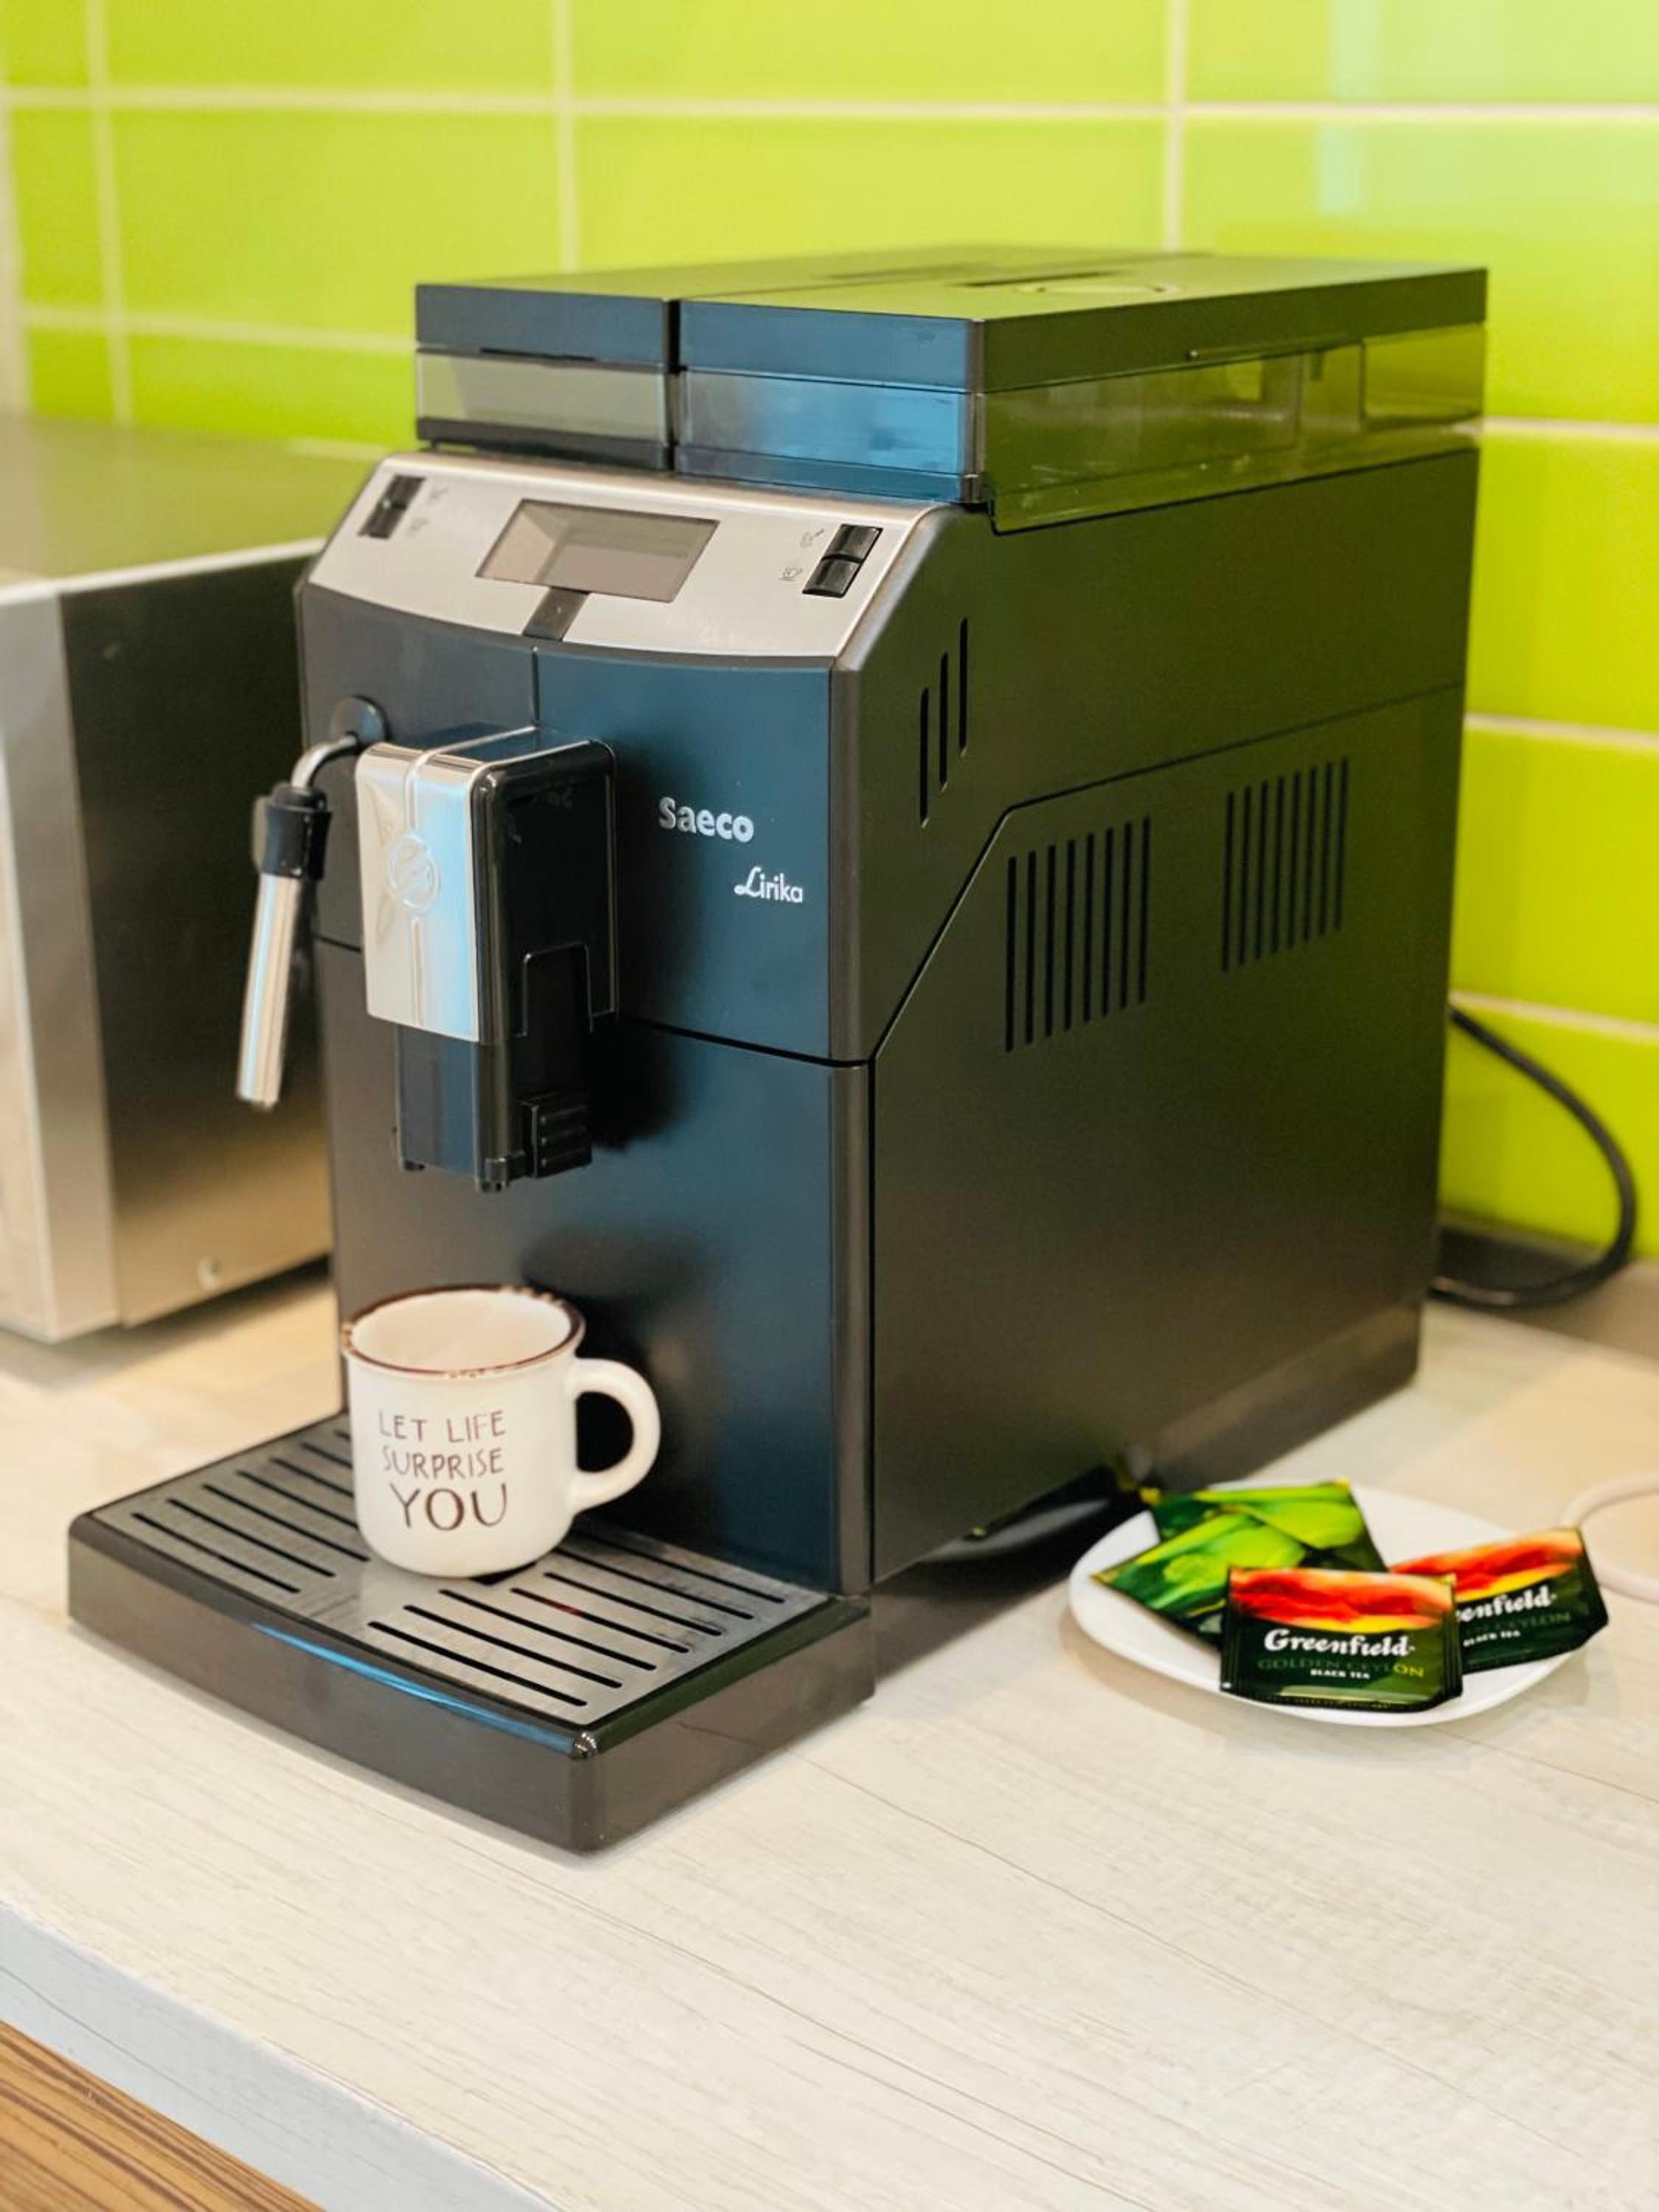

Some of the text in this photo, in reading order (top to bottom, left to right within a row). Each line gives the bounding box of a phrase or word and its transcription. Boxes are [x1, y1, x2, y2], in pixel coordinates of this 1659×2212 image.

[658, 796, 755, 843] Saeco
[734, 866, 804, 904] Lirika
[378, 1409, 507, 1444] LET LIFE
[381, 1444, 504, 1481] SURPRISE
[389, 1482, 508, 1531] YOU
[1455, 1585, 1552, 1623] enfield
[1264, 1628, 1411, 1657] Greenfield
[1256, 1658, 1341, 1671] GOLDEN
[1310, 1669, 1371, 1680] BLACK TEA
